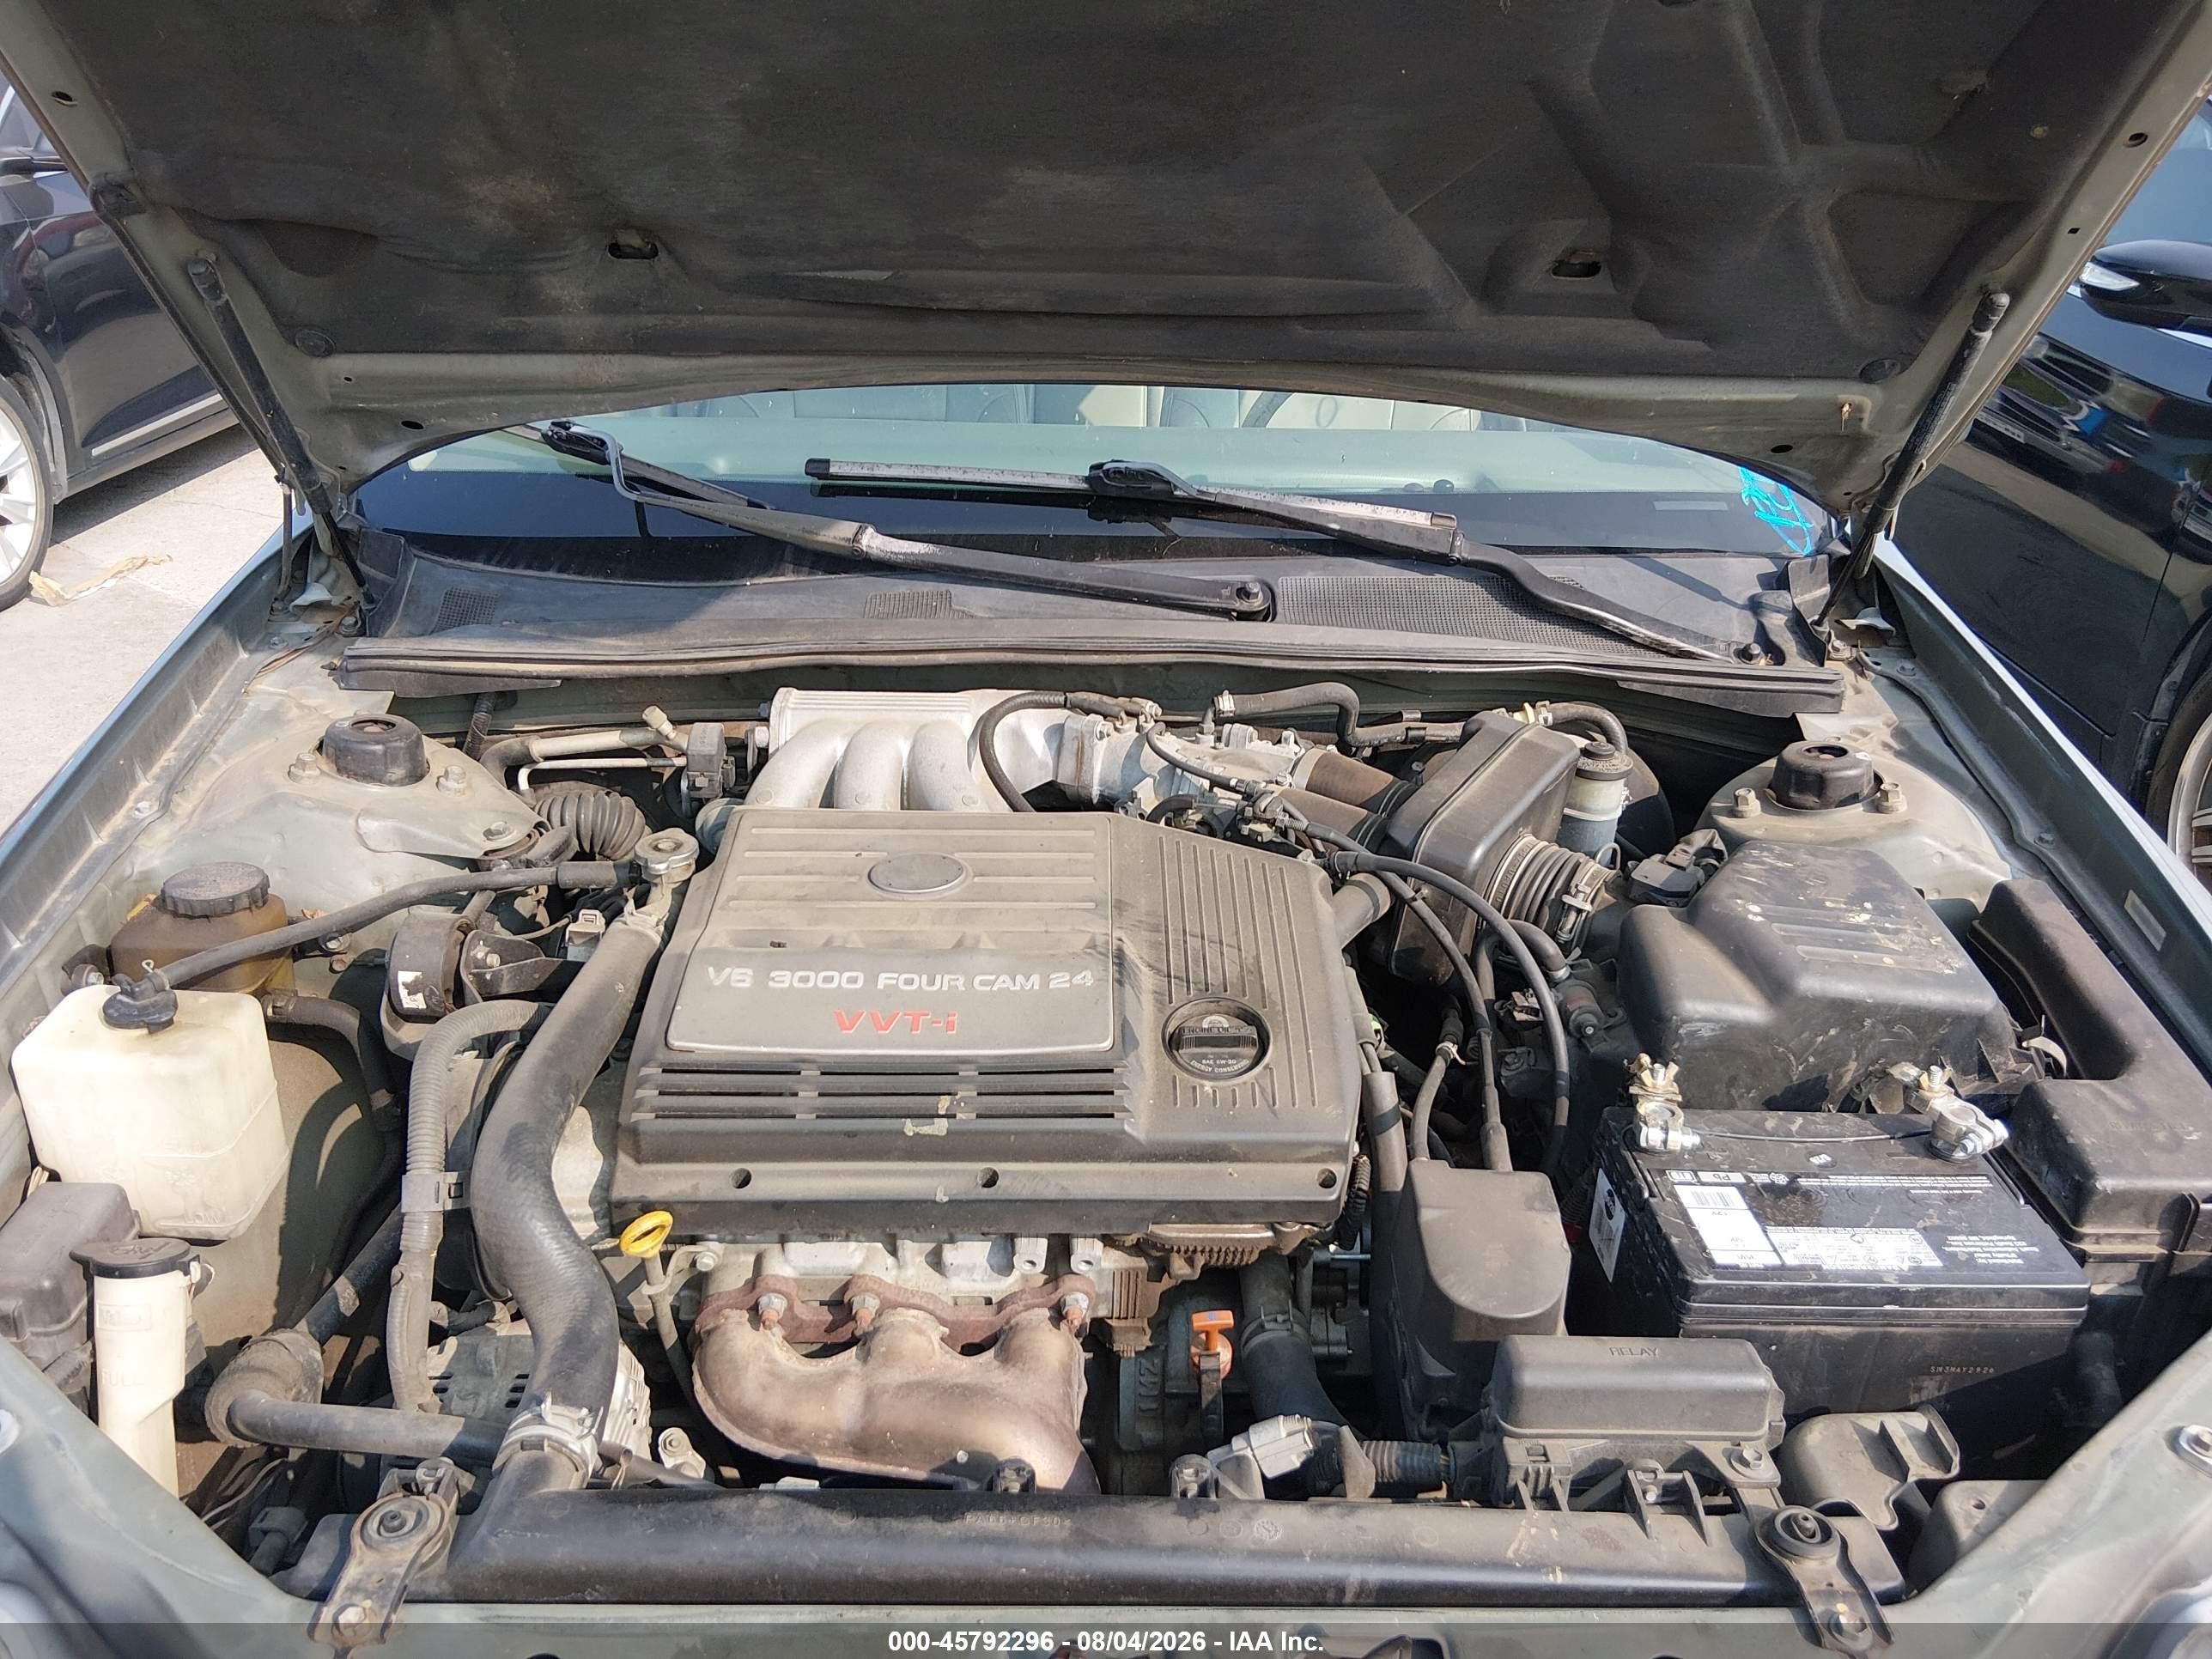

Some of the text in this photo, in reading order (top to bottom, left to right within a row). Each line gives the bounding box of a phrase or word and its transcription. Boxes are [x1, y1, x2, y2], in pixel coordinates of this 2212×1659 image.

[707, 966, 1095, 991] V6 3000 FOUR CAM 24
[833, 1008, 959, 1034] VVT-i
[1608, 1346, 1658, 1357] RELAY
